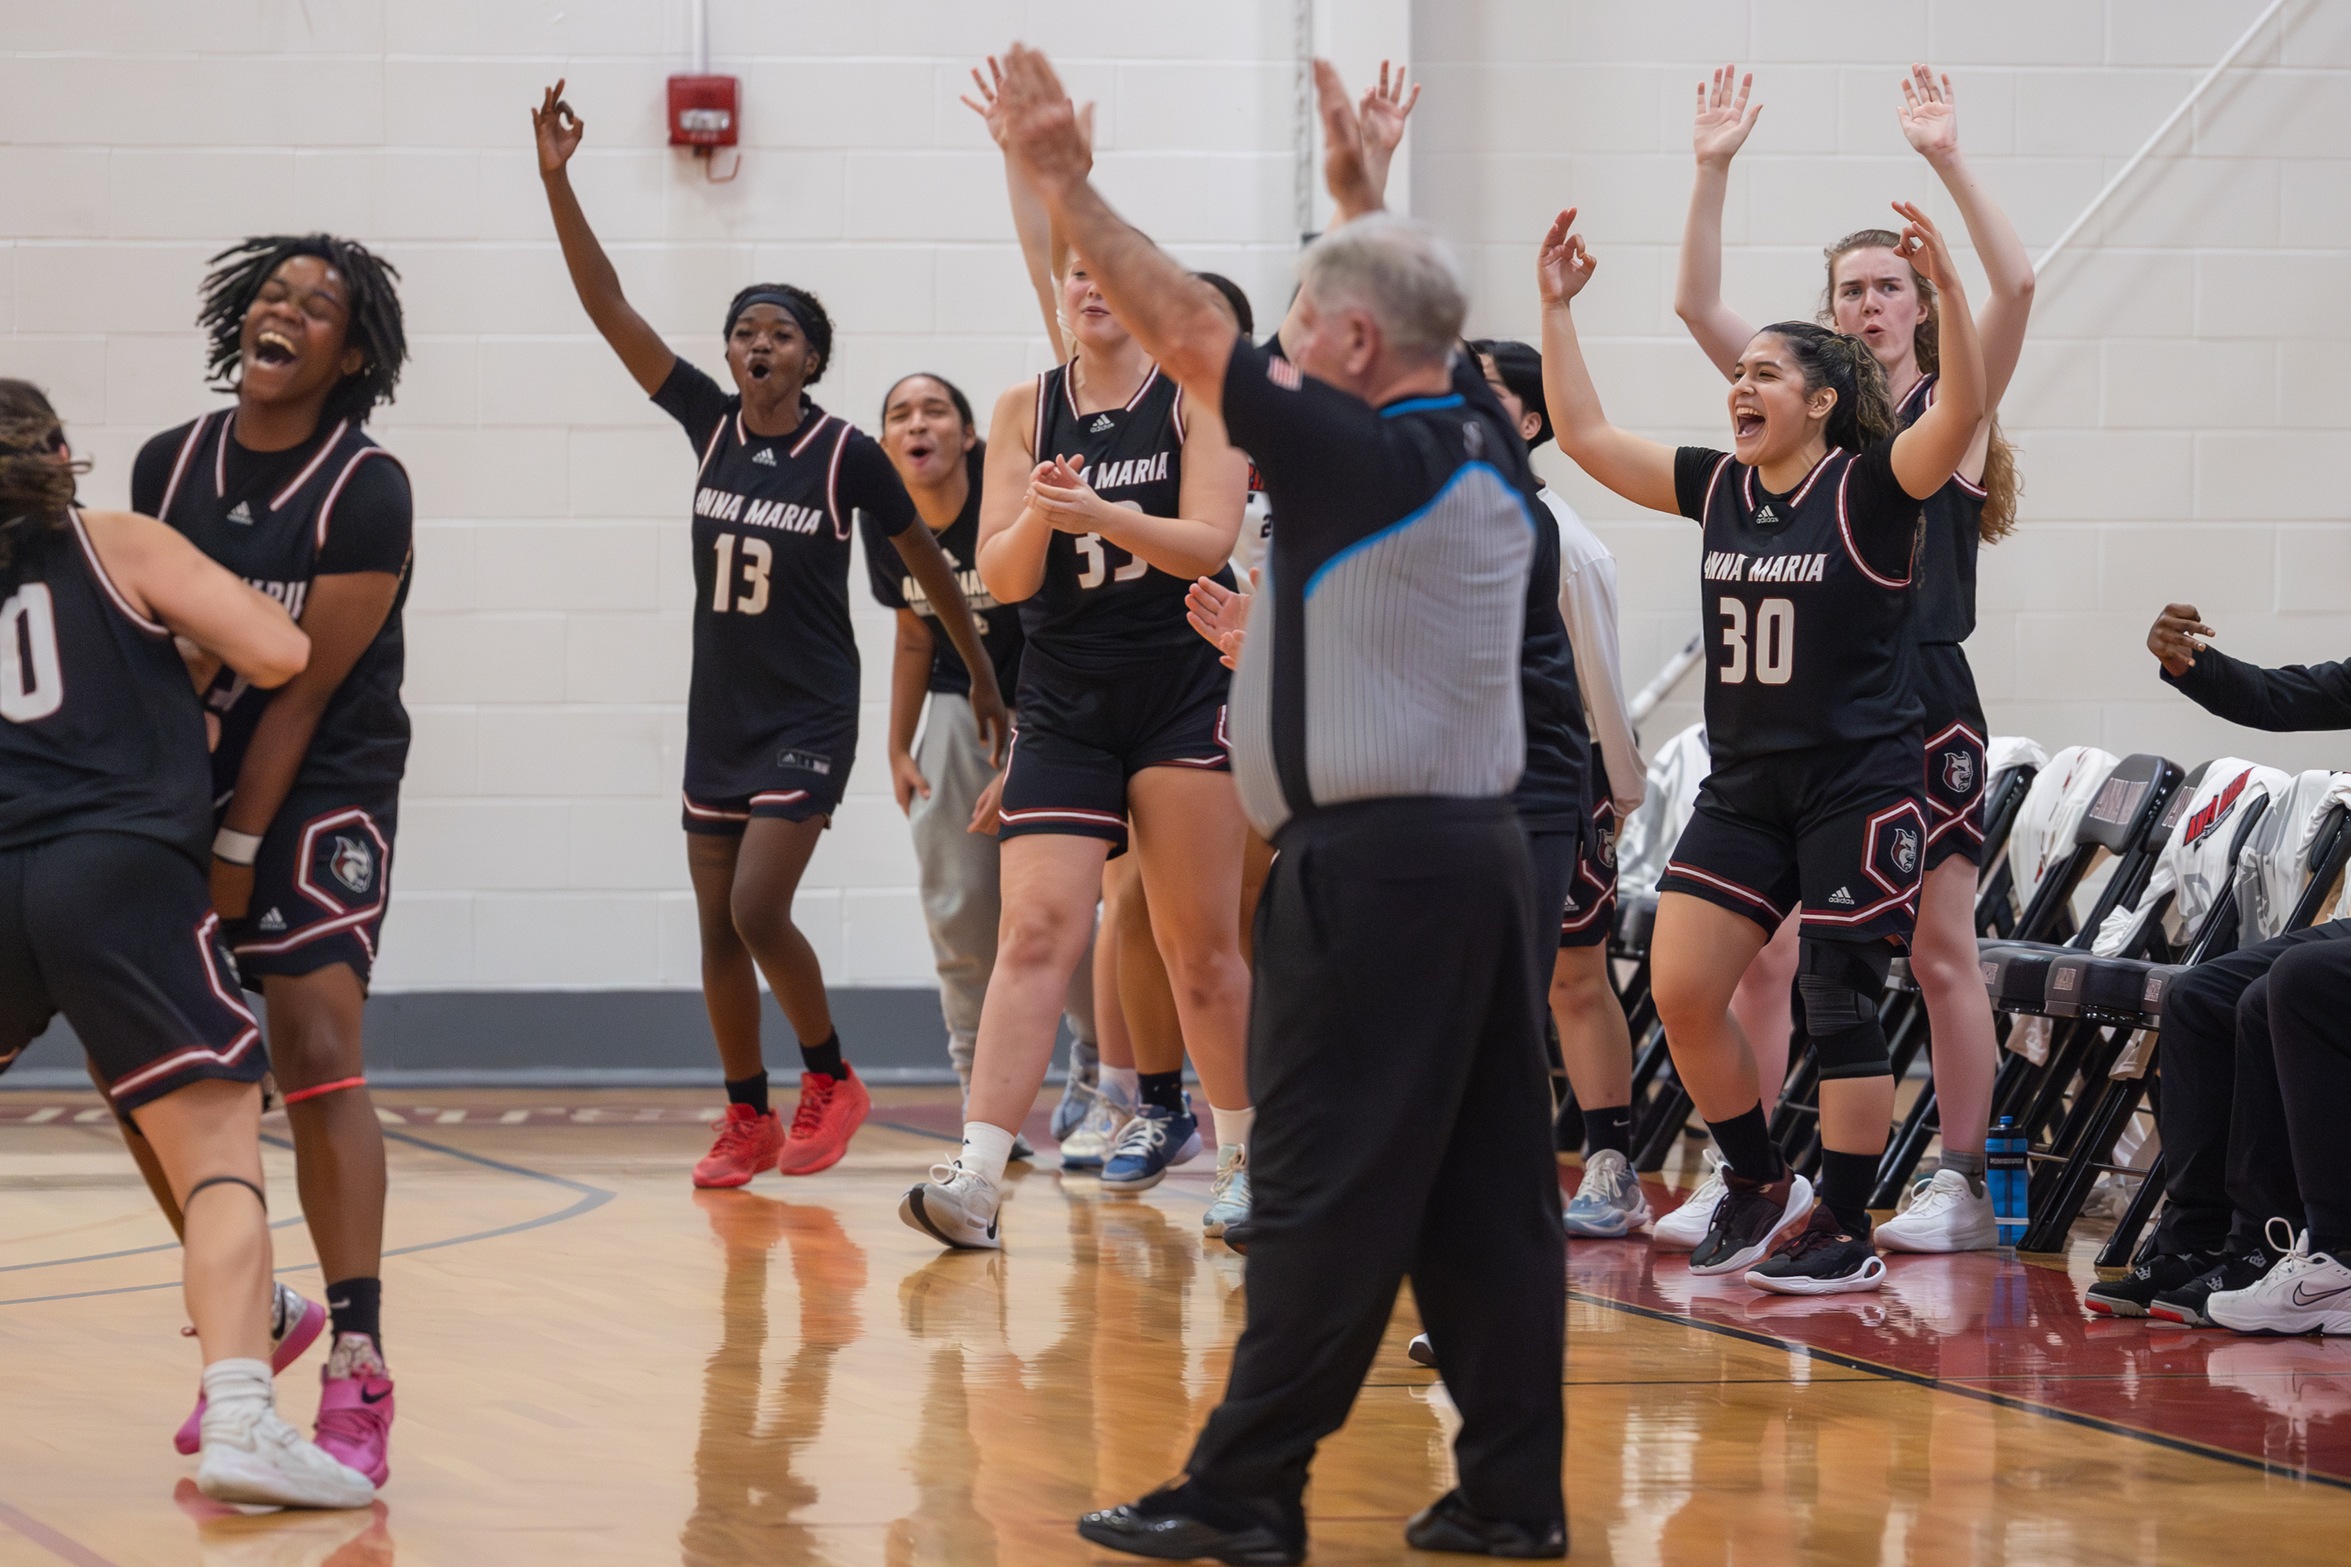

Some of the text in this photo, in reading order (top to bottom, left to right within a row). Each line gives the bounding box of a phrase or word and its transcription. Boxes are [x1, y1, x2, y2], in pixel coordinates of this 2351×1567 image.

[1094, 452, 1169, 490] MARIA
[742, 499, 824, 536] MARIA
[713, 533, 773, 616] 13
[1748, 553, 1829, 582] MARIA
[1719, 597, 1795, 685] 30
